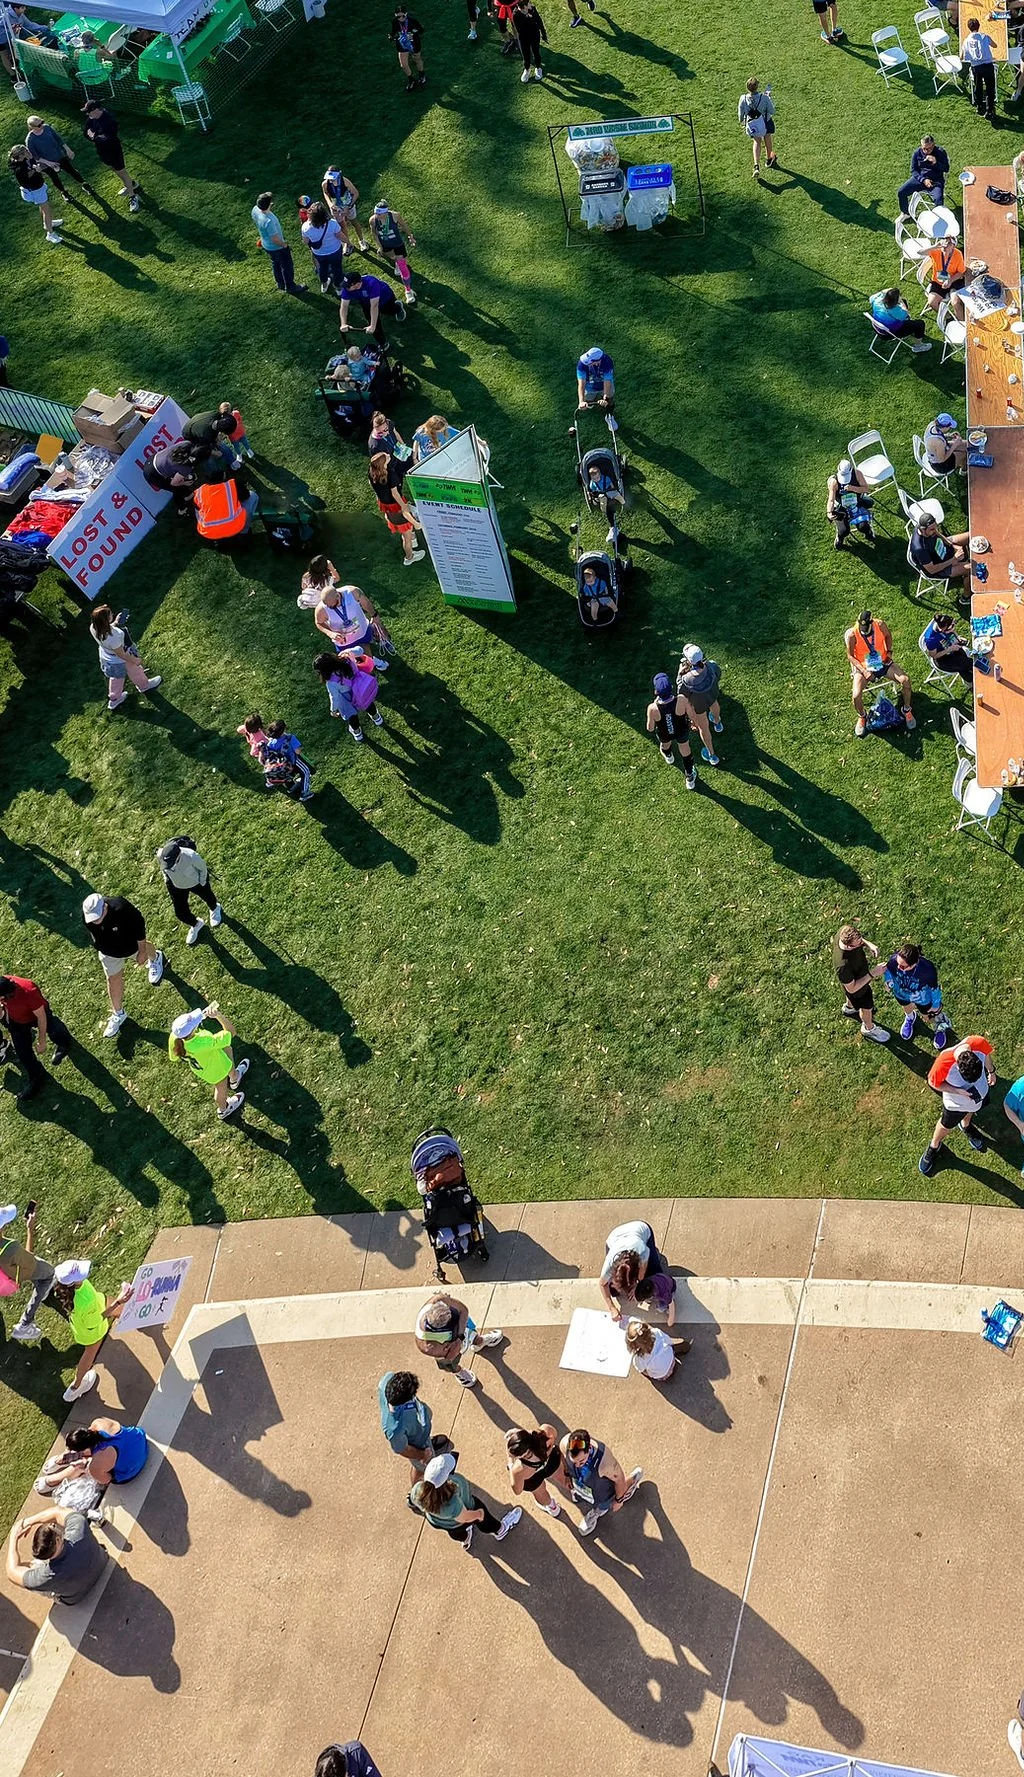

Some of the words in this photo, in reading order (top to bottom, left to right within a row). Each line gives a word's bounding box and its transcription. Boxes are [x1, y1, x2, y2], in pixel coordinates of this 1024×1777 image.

[135, 424, 175, 468] LOST
[422, 500, 444, 508] EVENT
[446, 503, 482, 513] SCHEDULE
[60, 509, 111, 570] LOST
[111, 491, 128, 510] &
[75, 506, 144, 587] FOUND
[141, 1267, 153, 1280] GO
[138, 1304, 152, 1319] GO
